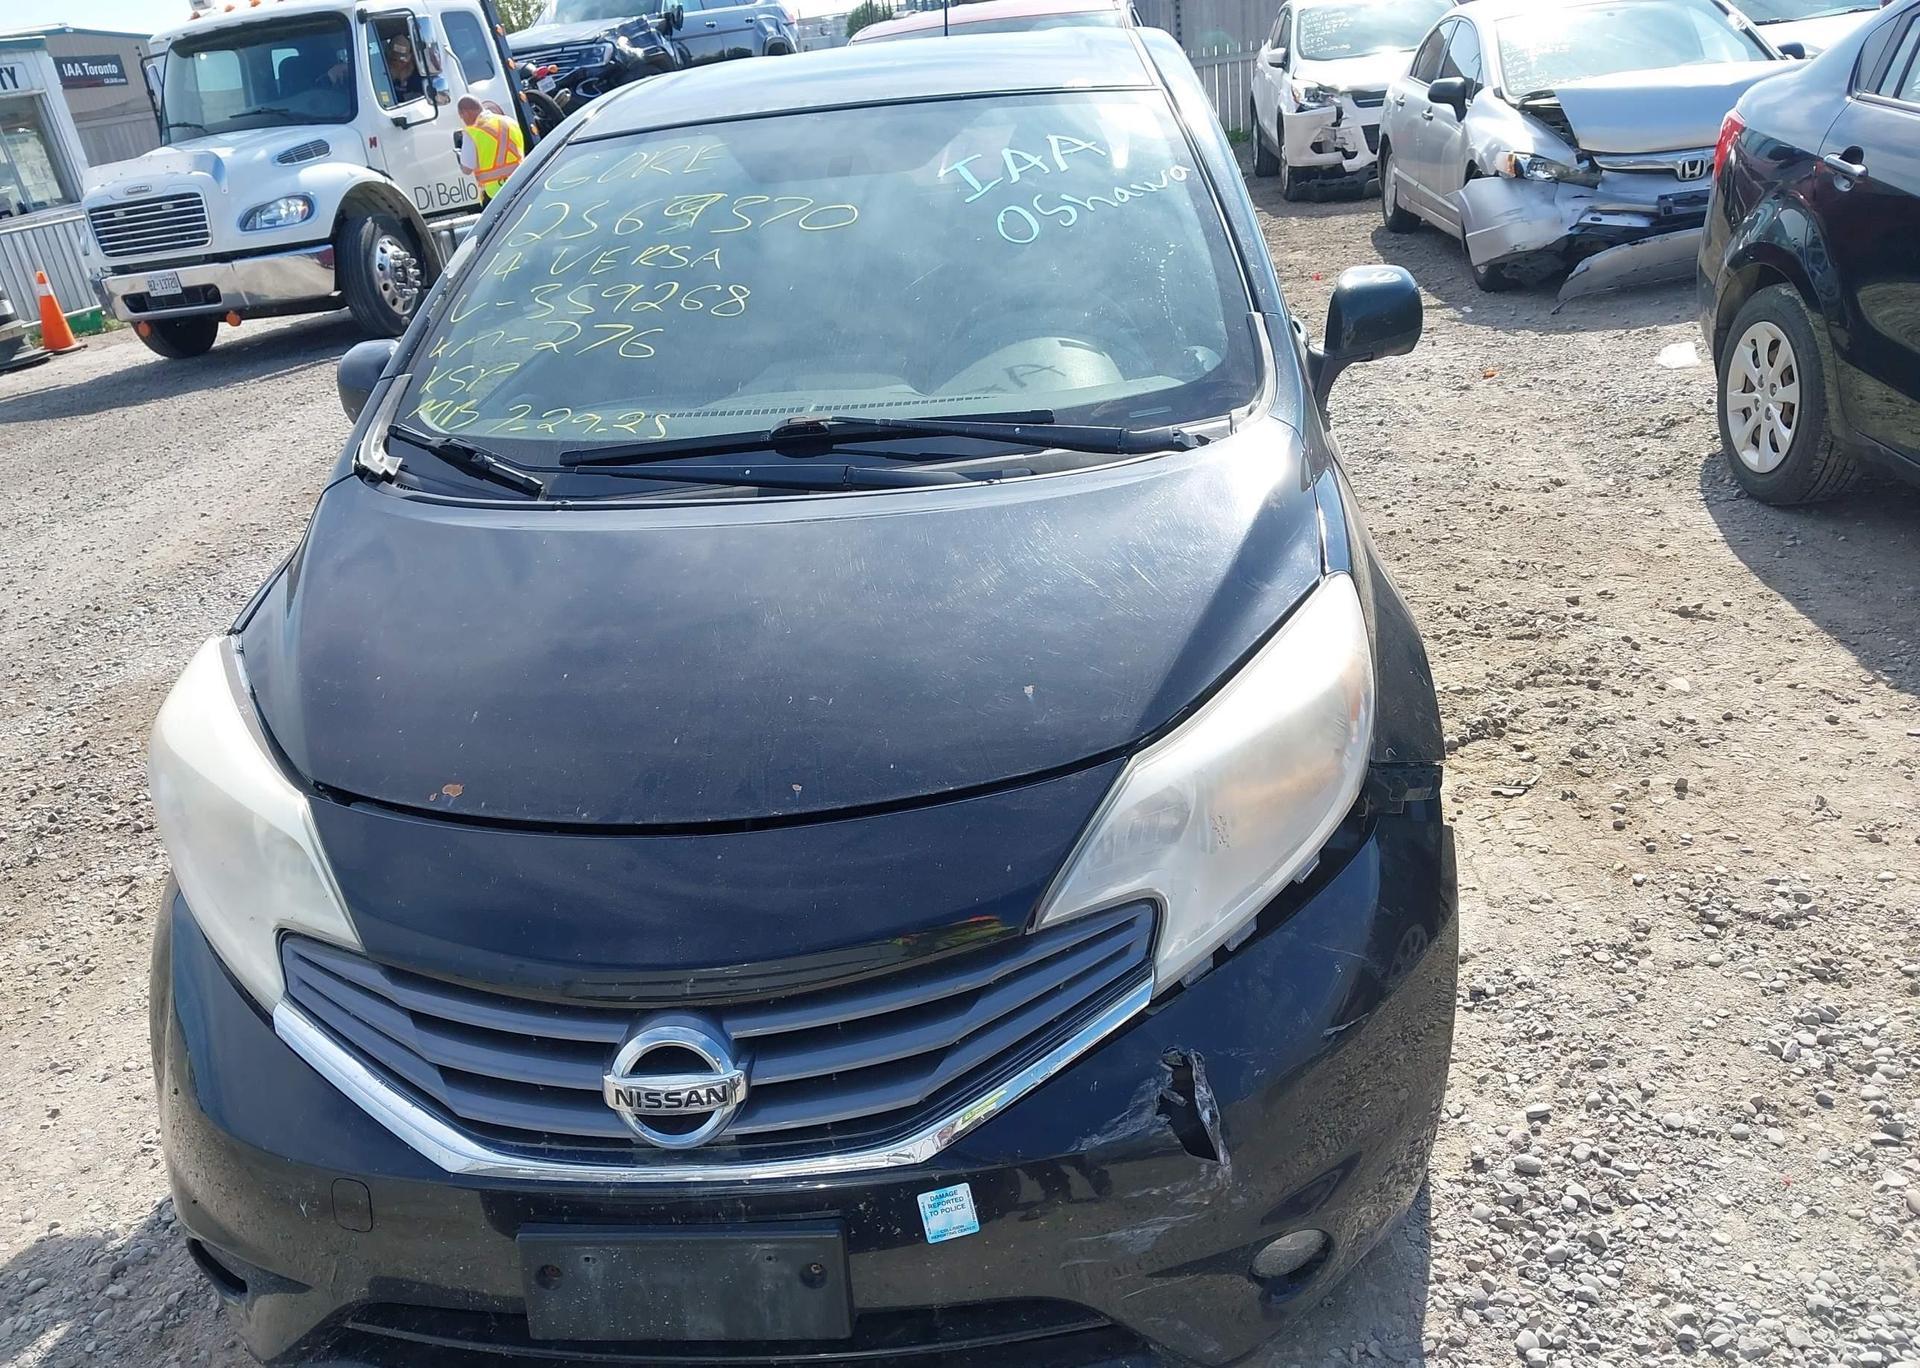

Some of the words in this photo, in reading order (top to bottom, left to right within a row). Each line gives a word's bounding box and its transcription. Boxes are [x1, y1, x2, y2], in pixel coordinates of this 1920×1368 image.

[62, 63, 83, 77] IAA
[82, 62, 118, 76] Toronto
[544, 143, 729, 190] GORE
[936, 134, 1106, 204] IAA
[413, 184, 435, 210] Di
[436, 177, 478, 206] Bello
[478, 251, 521, 281] 14
[550, 245, 721, 275] VERSA
[614, 1084, 728, 1109] NISSAN
[927, 1196, 964, 1209] REPORTED
[930, 1190, 958, 1201] DAMAGE
[940, 1203, 966, 1214] POLICE
